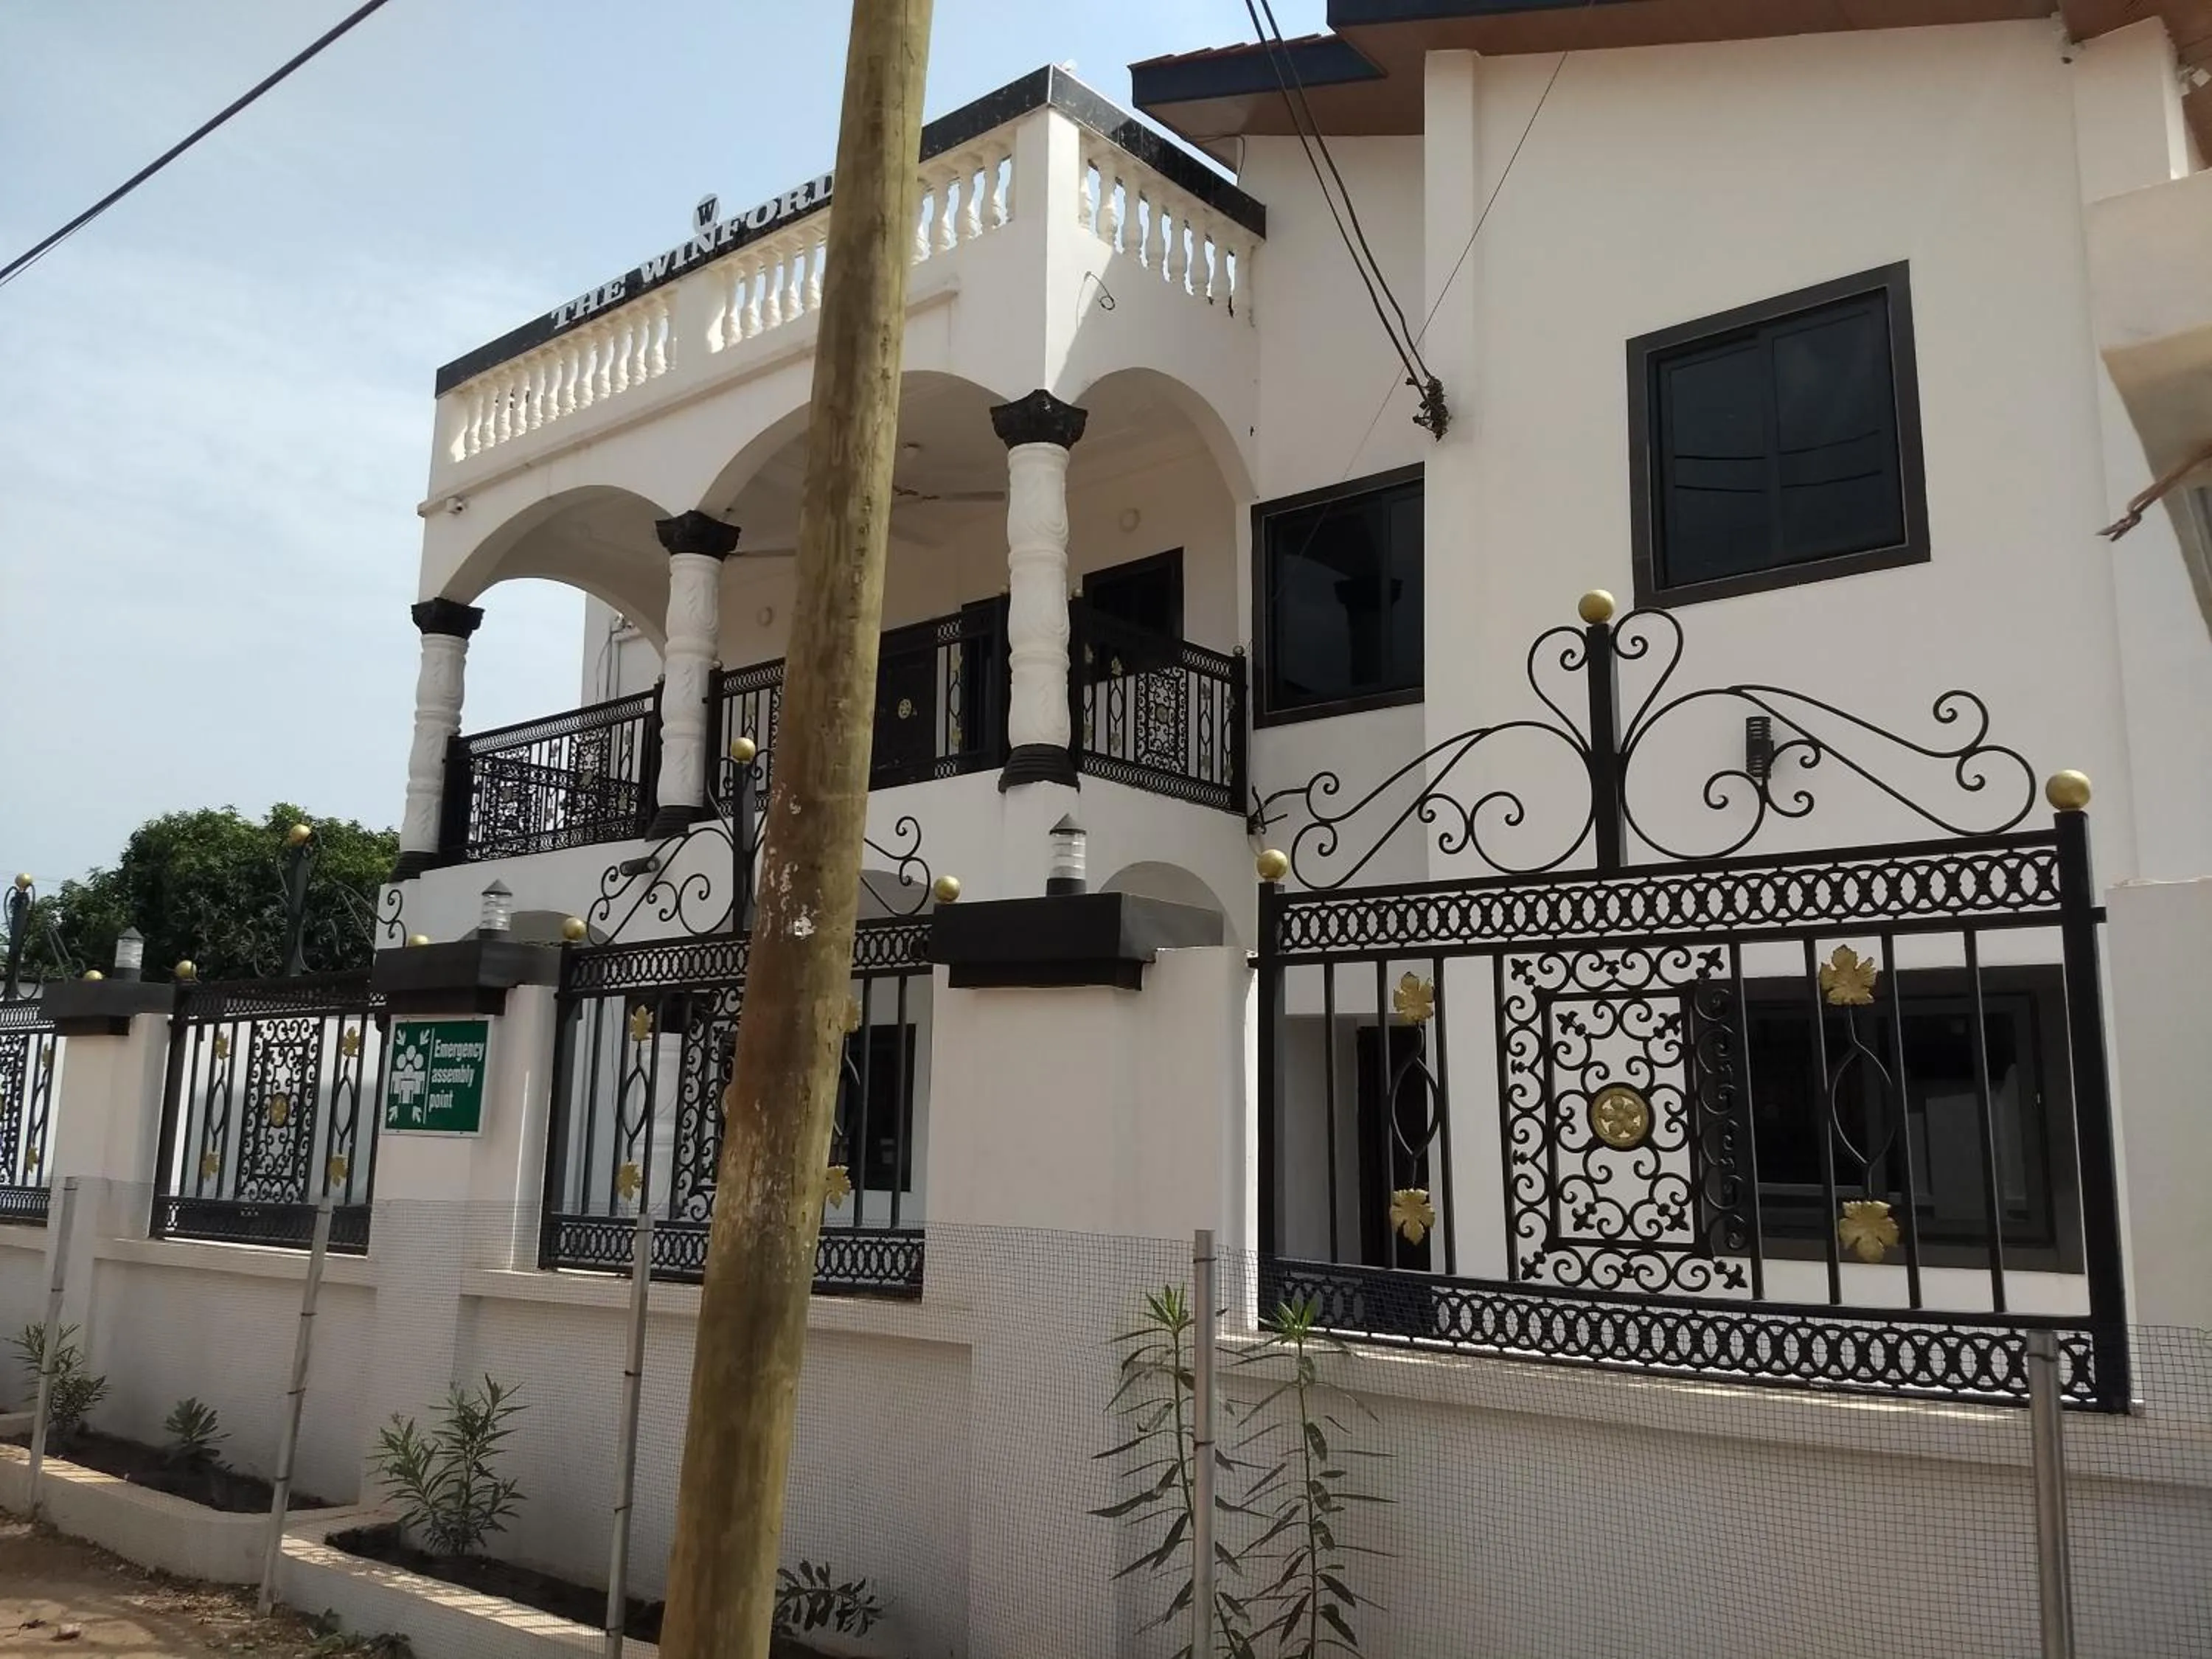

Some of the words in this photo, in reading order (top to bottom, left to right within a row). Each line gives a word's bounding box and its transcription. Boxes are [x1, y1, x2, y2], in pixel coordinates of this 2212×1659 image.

[697, 197, 717, 226] W
[551, 275, 627, 330] THE
[434, 1039, 484, 1062] Emergency
[431, 1064, 475, 1088] assembly
[428, 1088, 453, 1113] point
